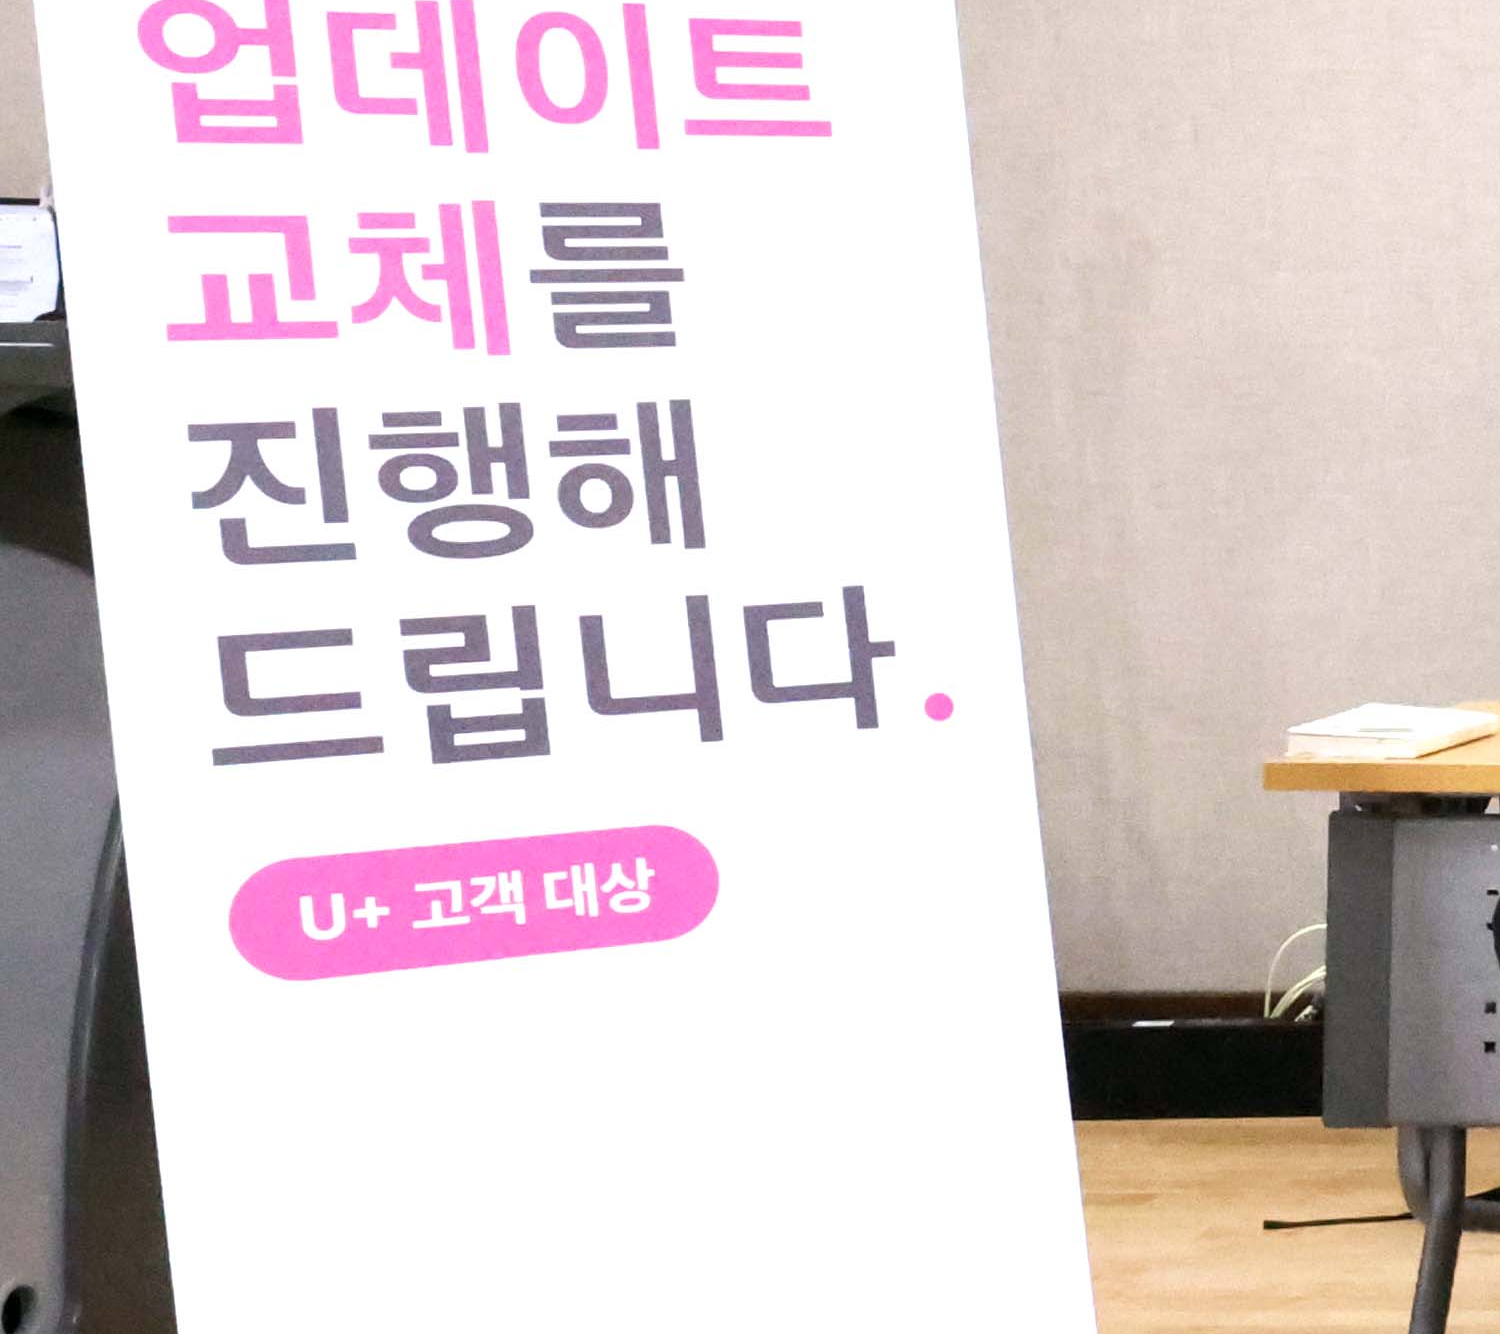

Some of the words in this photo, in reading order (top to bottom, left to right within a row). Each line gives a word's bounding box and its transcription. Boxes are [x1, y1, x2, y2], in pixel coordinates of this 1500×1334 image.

[167, 201, 684, 355] 교체를
[188, 400, 705, 565] 진행해
[212, 586, 953, 766] 드립니다.
[300, 894, 389, 940] U+
[413, 871, 525, 928] 고객
[544, 858, 654, 916] 대상
